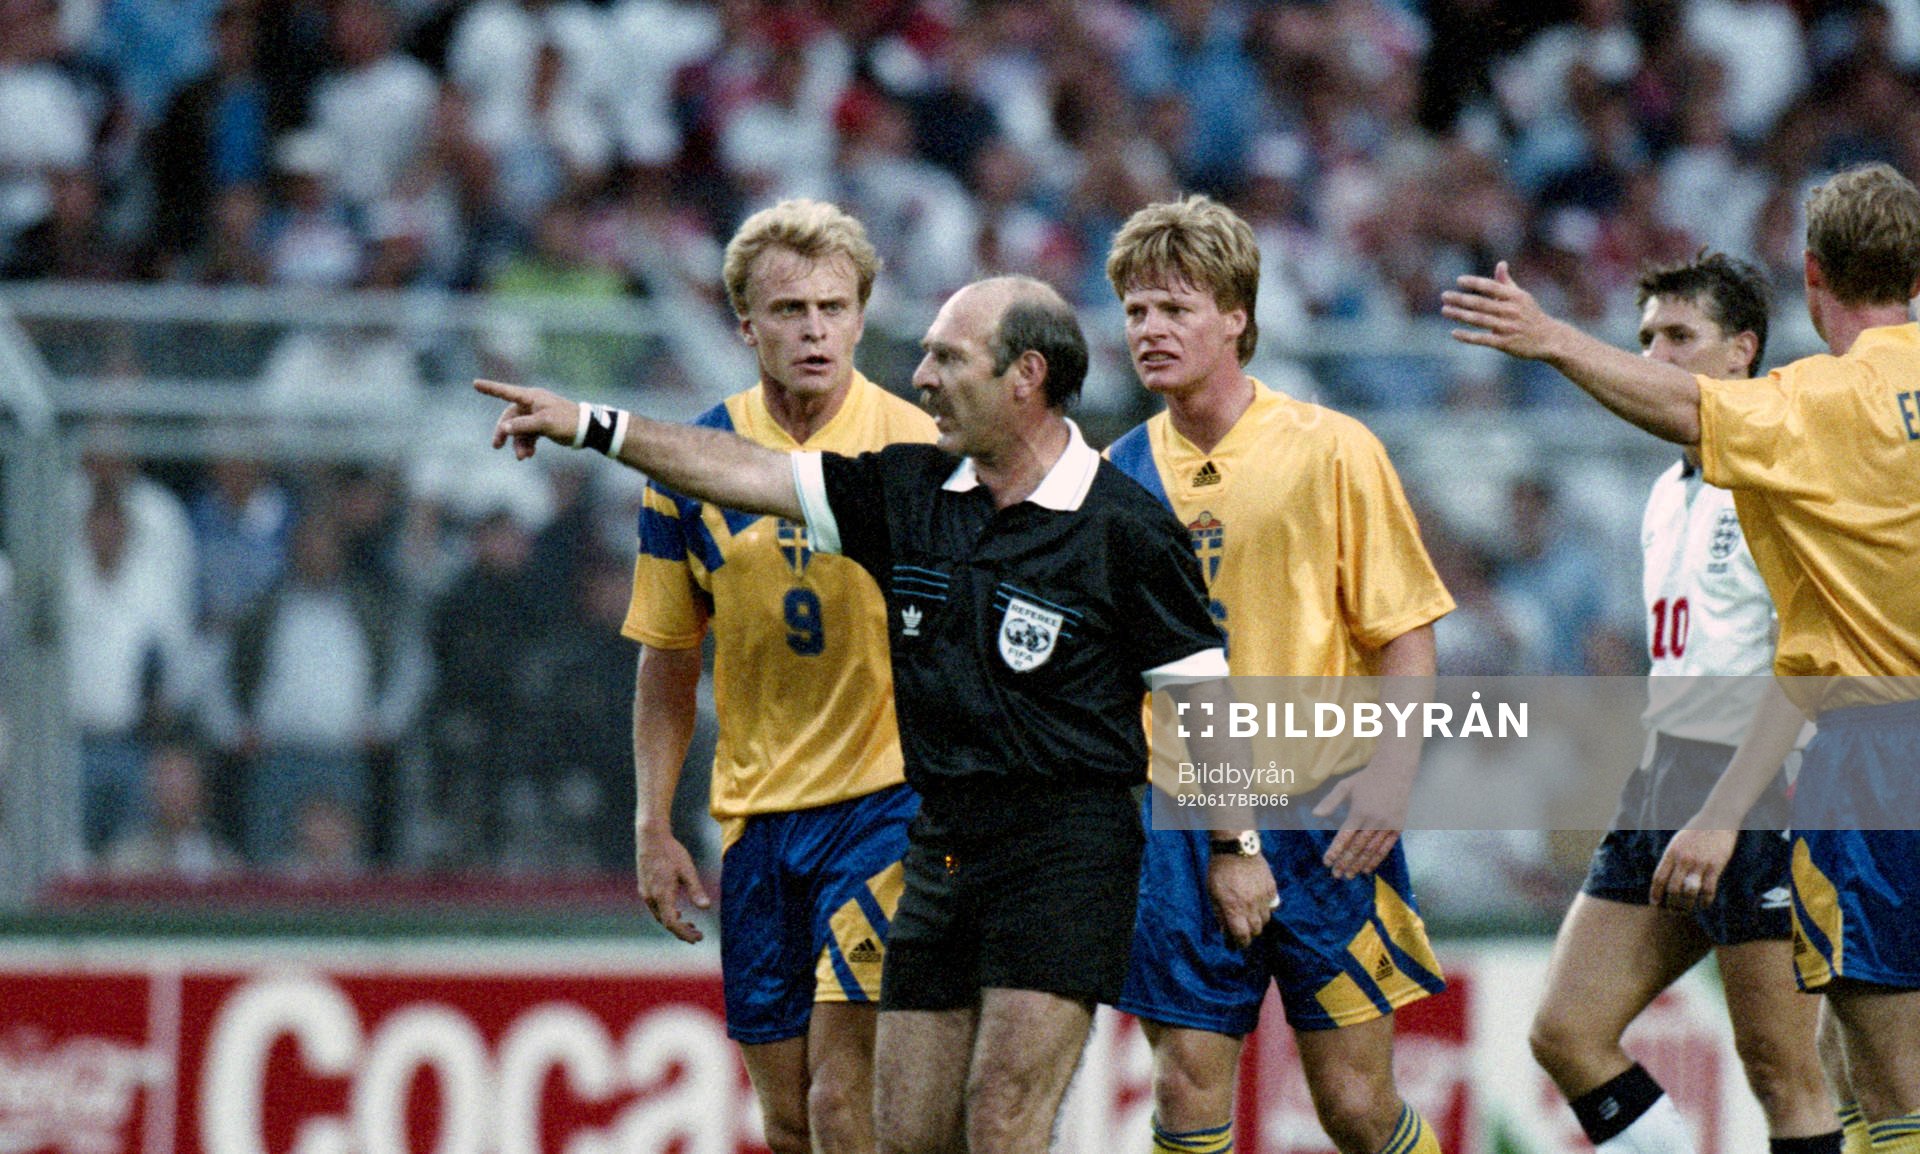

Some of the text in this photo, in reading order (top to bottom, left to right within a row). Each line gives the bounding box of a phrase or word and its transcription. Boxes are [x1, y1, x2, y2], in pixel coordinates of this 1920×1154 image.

[1896, 391, 1920, 440] E
[783, 587, 825, 657] 9
[1011, 603, 1058, 627] REFEREE
[1651, 597, 1689, 658] 10
[1008, 647, 1034, 662] FIFA
